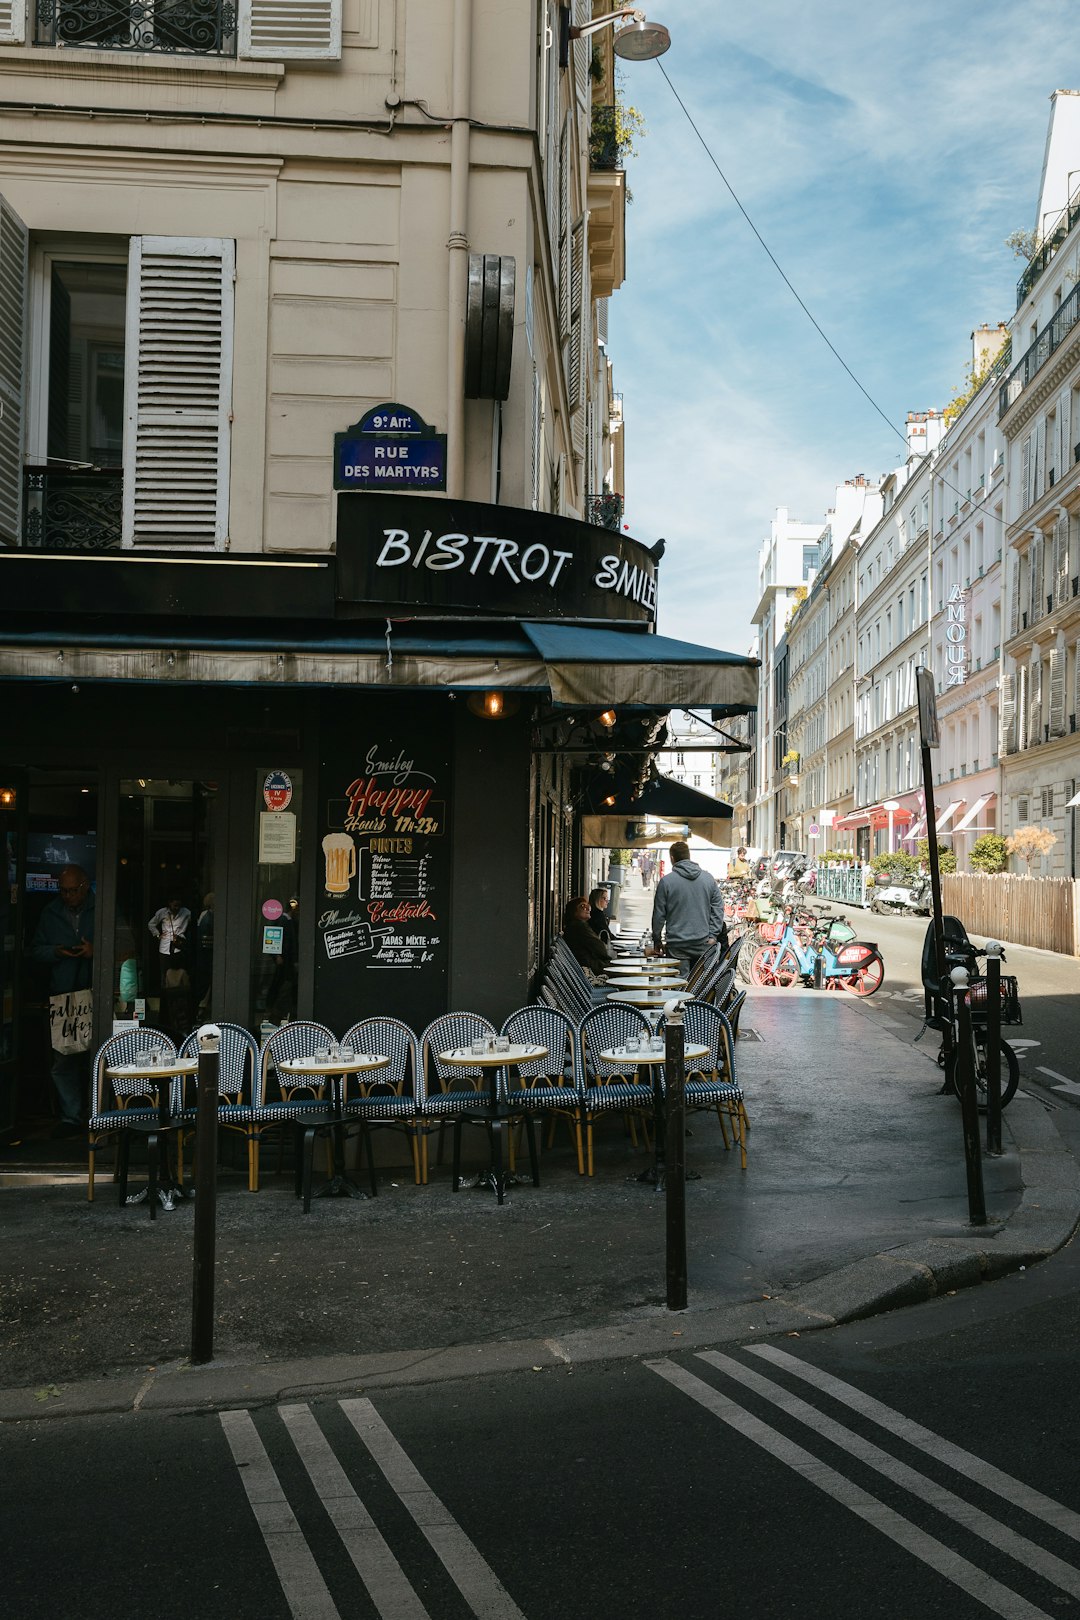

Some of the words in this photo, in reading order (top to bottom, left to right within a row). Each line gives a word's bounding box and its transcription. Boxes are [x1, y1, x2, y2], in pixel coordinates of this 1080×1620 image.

[374, 447, 409, 459] RUE
[344, 465, 370, 477] DES
[375, 466, 440, 478] MARTYRS
[376, 528, 574, 589] BISTROT
[595, 555, 656, 614] SMILE
[365, 744, 428, 785] Smiley
[345, 777, 433, 819] Happy
[344, 816, 387, 834] Hours
[369, 837, 413, 854] PINTES
[367, 900, 437, 923] Cocktails
[381, 935, 404, 946] TAPAS
